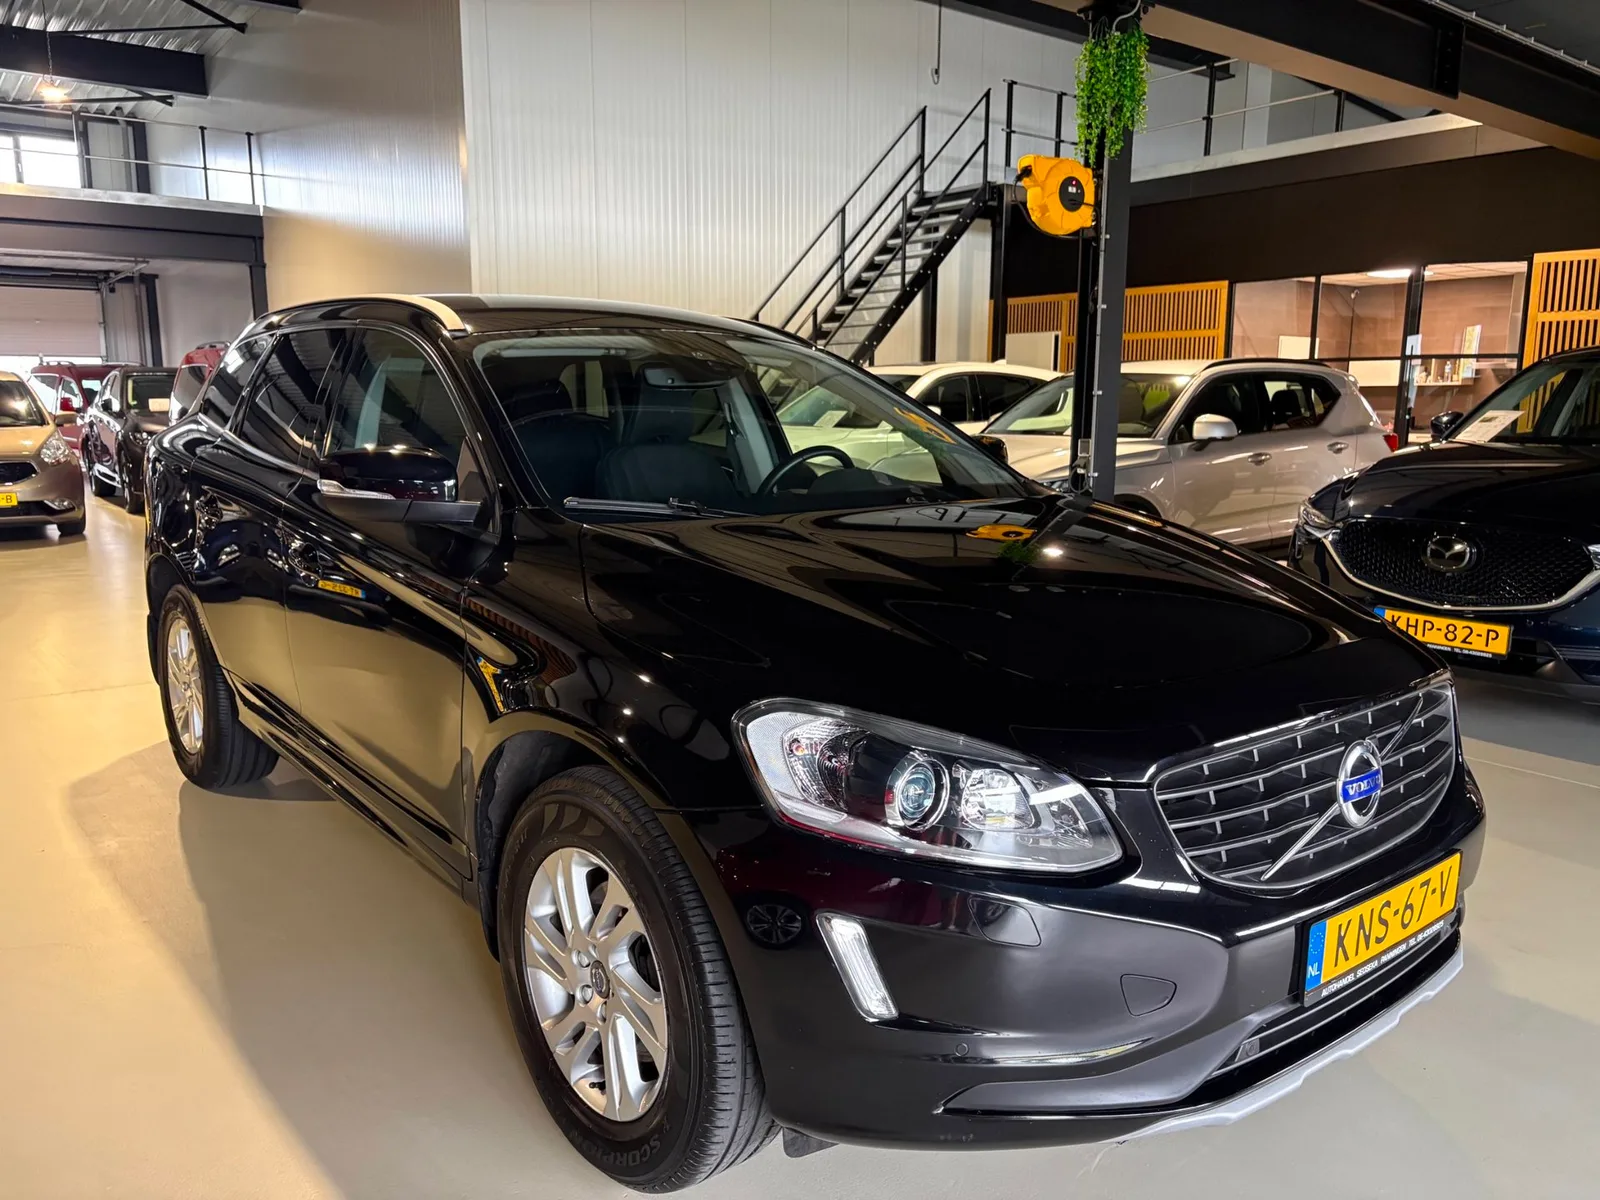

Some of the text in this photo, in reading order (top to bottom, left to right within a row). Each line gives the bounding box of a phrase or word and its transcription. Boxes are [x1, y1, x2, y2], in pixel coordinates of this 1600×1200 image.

[1391, 614, 1500, 648] KHP-82-P
[1345, 775, 1380, 796] VOLVO
[1334, 865, 1453, 968] KNS-67-V
[1307, 961, 1320, 979] NL
